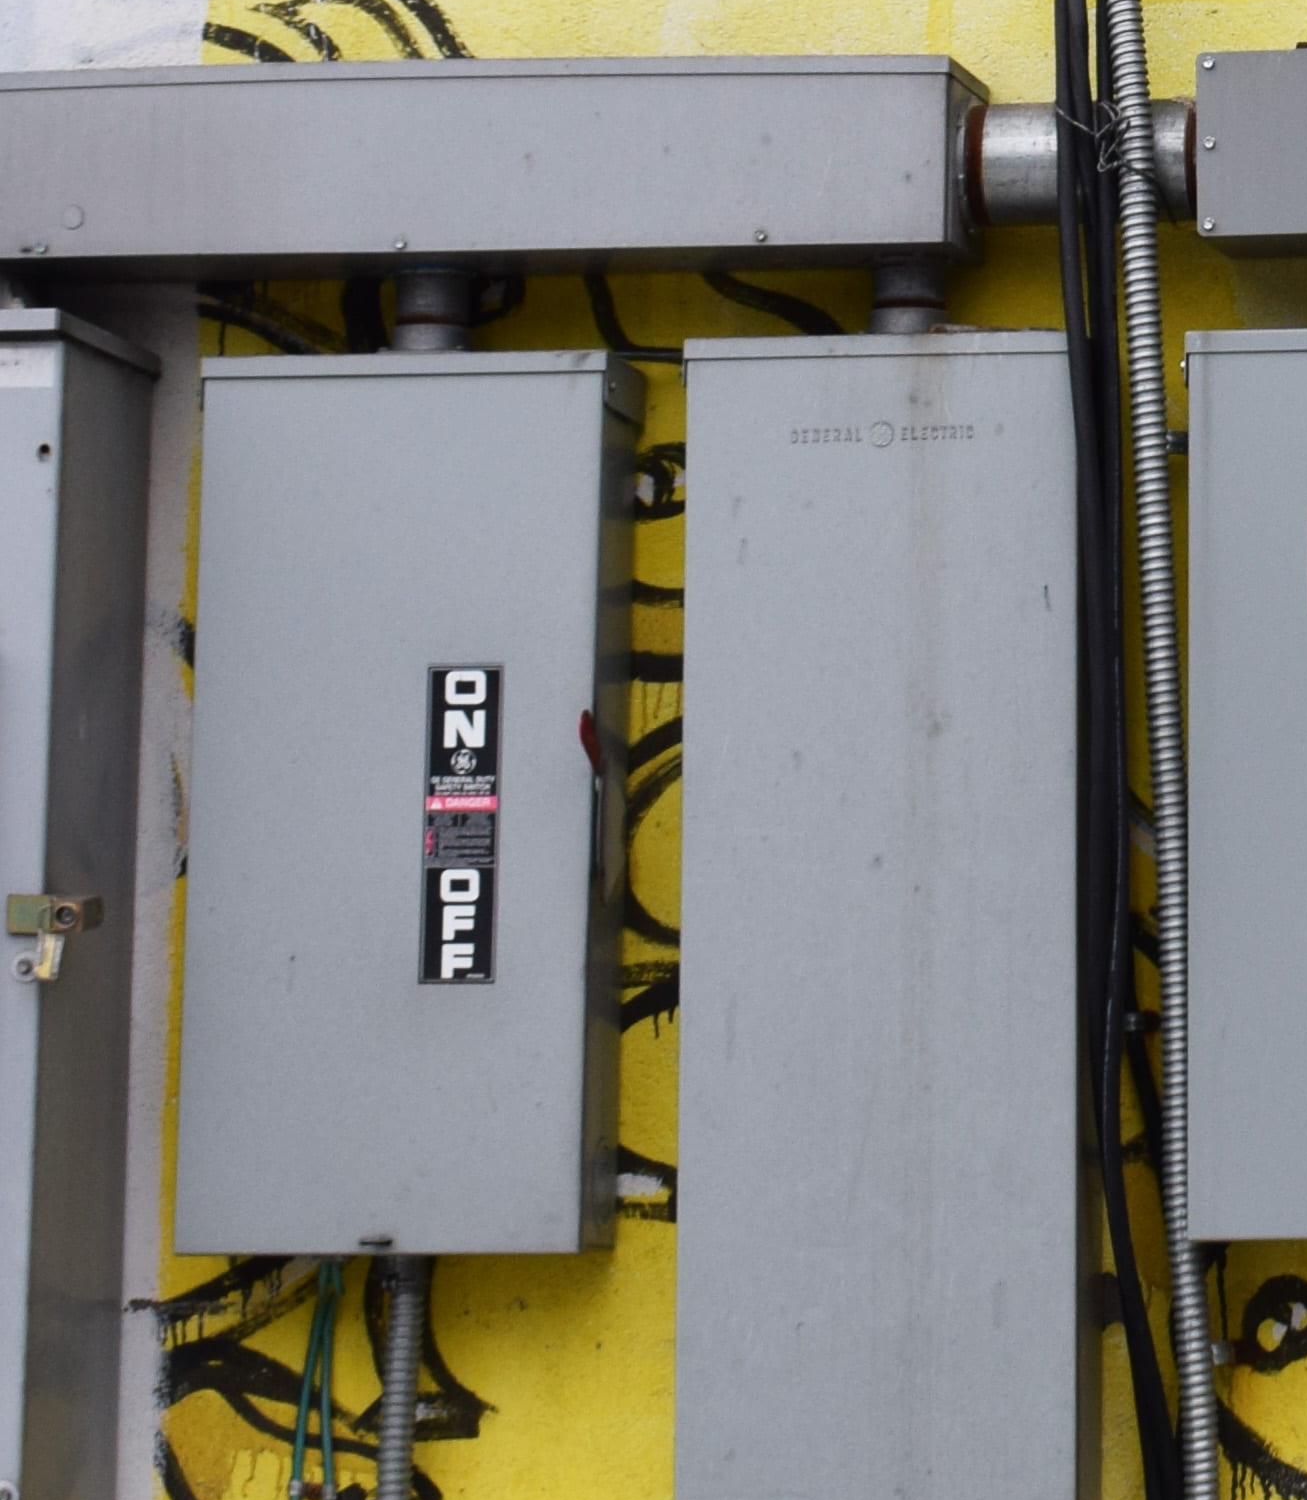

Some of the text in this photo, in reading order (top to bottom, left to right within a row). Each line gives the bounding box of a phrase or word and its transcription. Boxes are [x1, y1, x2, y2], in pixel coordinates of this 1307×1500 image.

[901, 424, 974, 441] ELECTRIC
[443, 670, 487, 748] ON
[445, 797, 491, 808] DANGER
[440, 869, 480, 979] OFF
